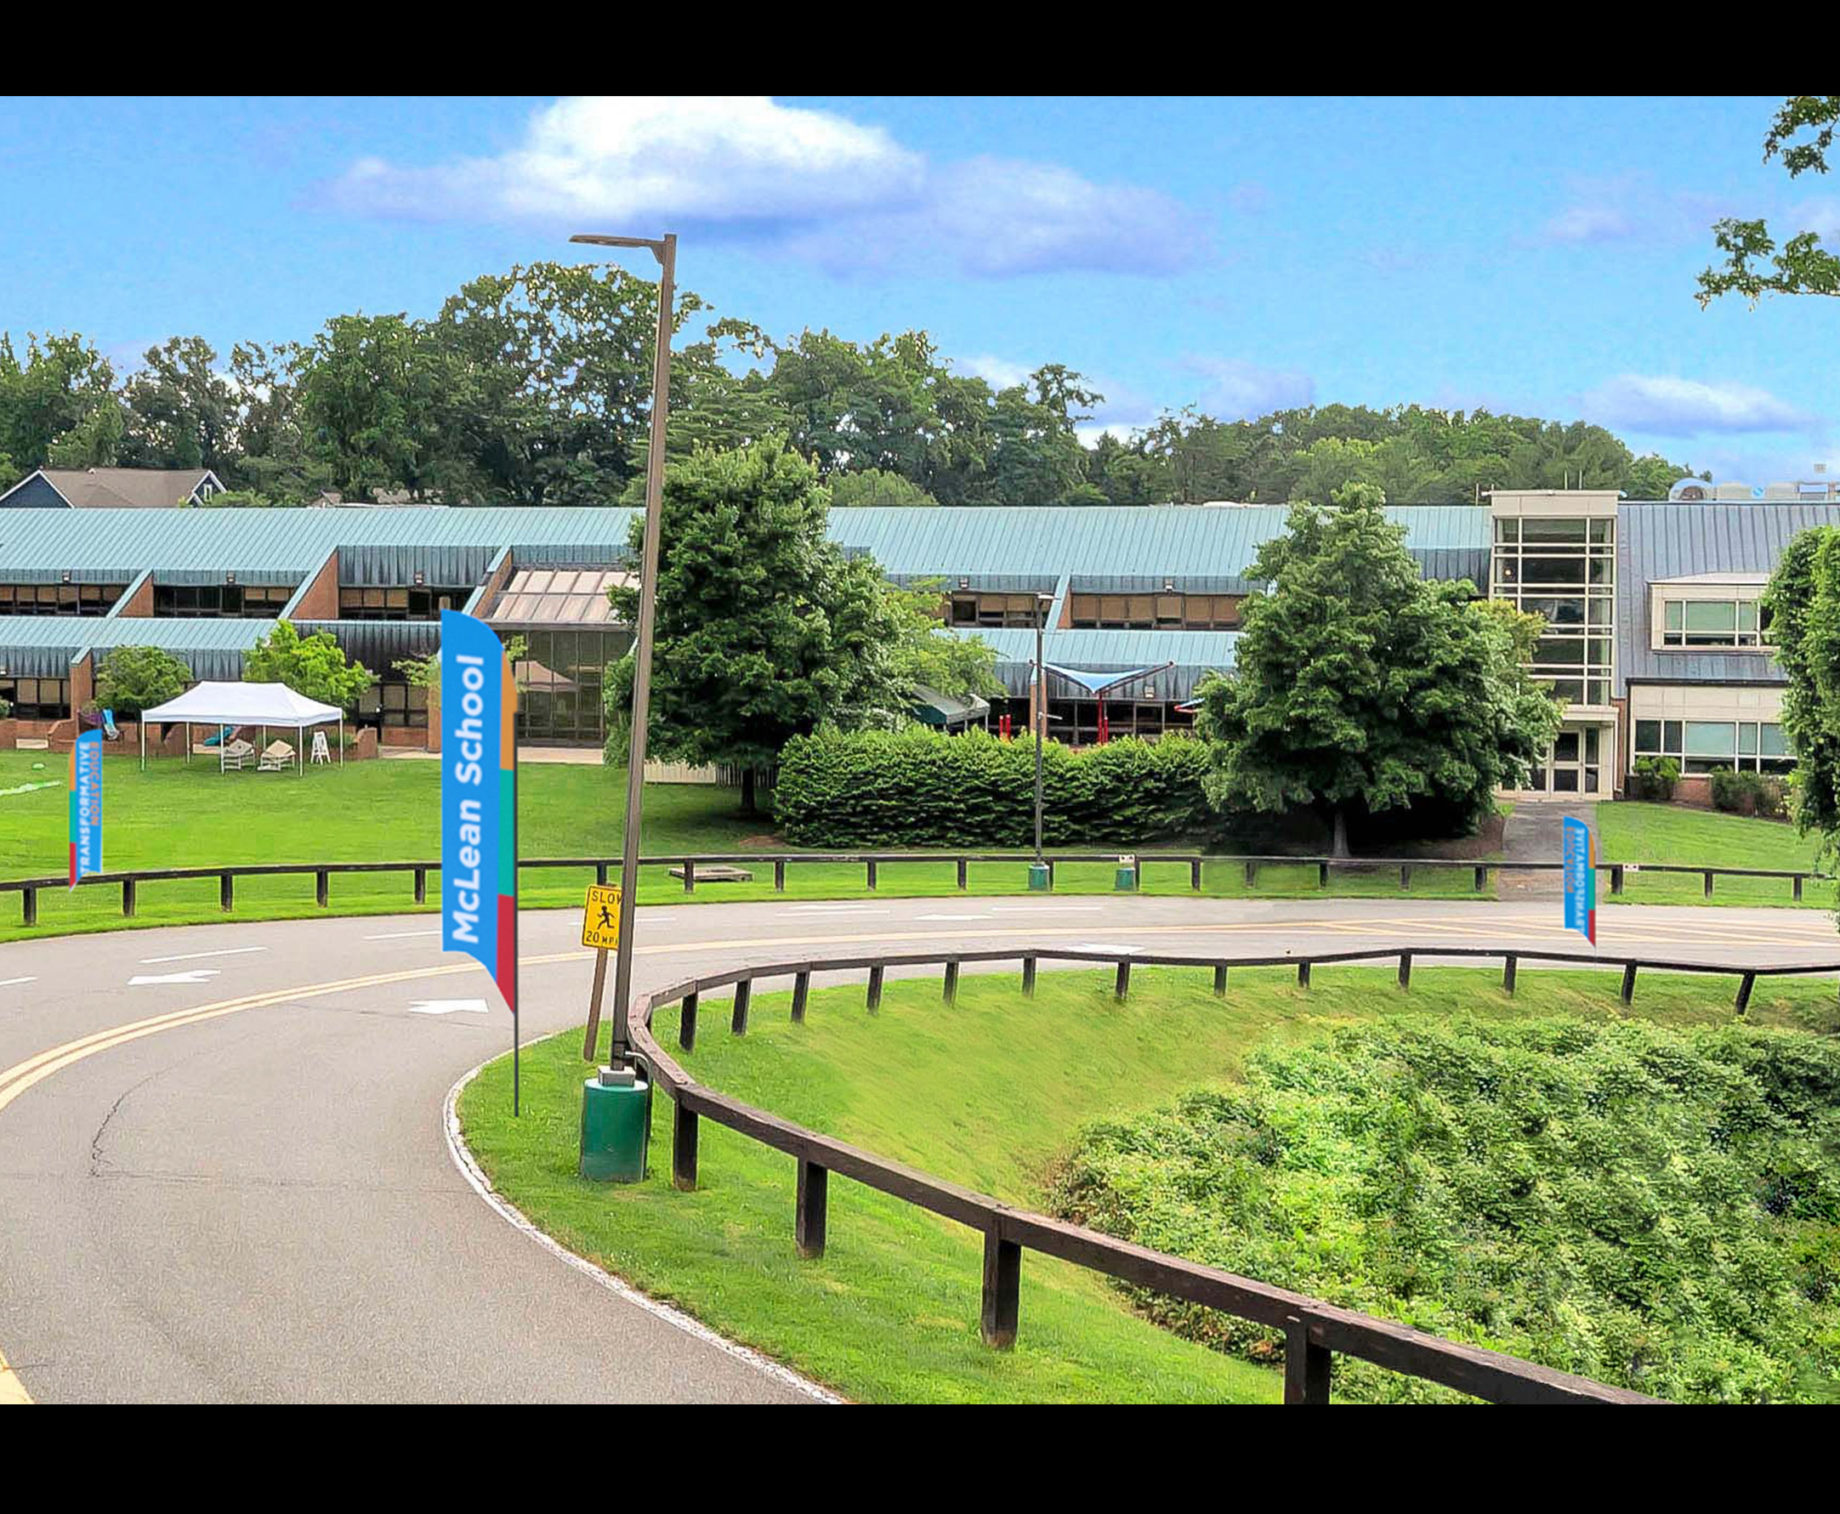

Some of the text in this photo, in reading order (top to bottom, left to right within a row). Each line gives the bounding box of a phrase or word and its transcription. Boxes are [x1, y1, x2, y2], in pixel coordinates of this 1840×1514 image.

[79, 742, 90, 874] TRANSFORMATIVE
[89, 742, 100, 826] EDUCATION
[452, 655, 484, 943] McLean School
[586, 930, 600, 943] 20
